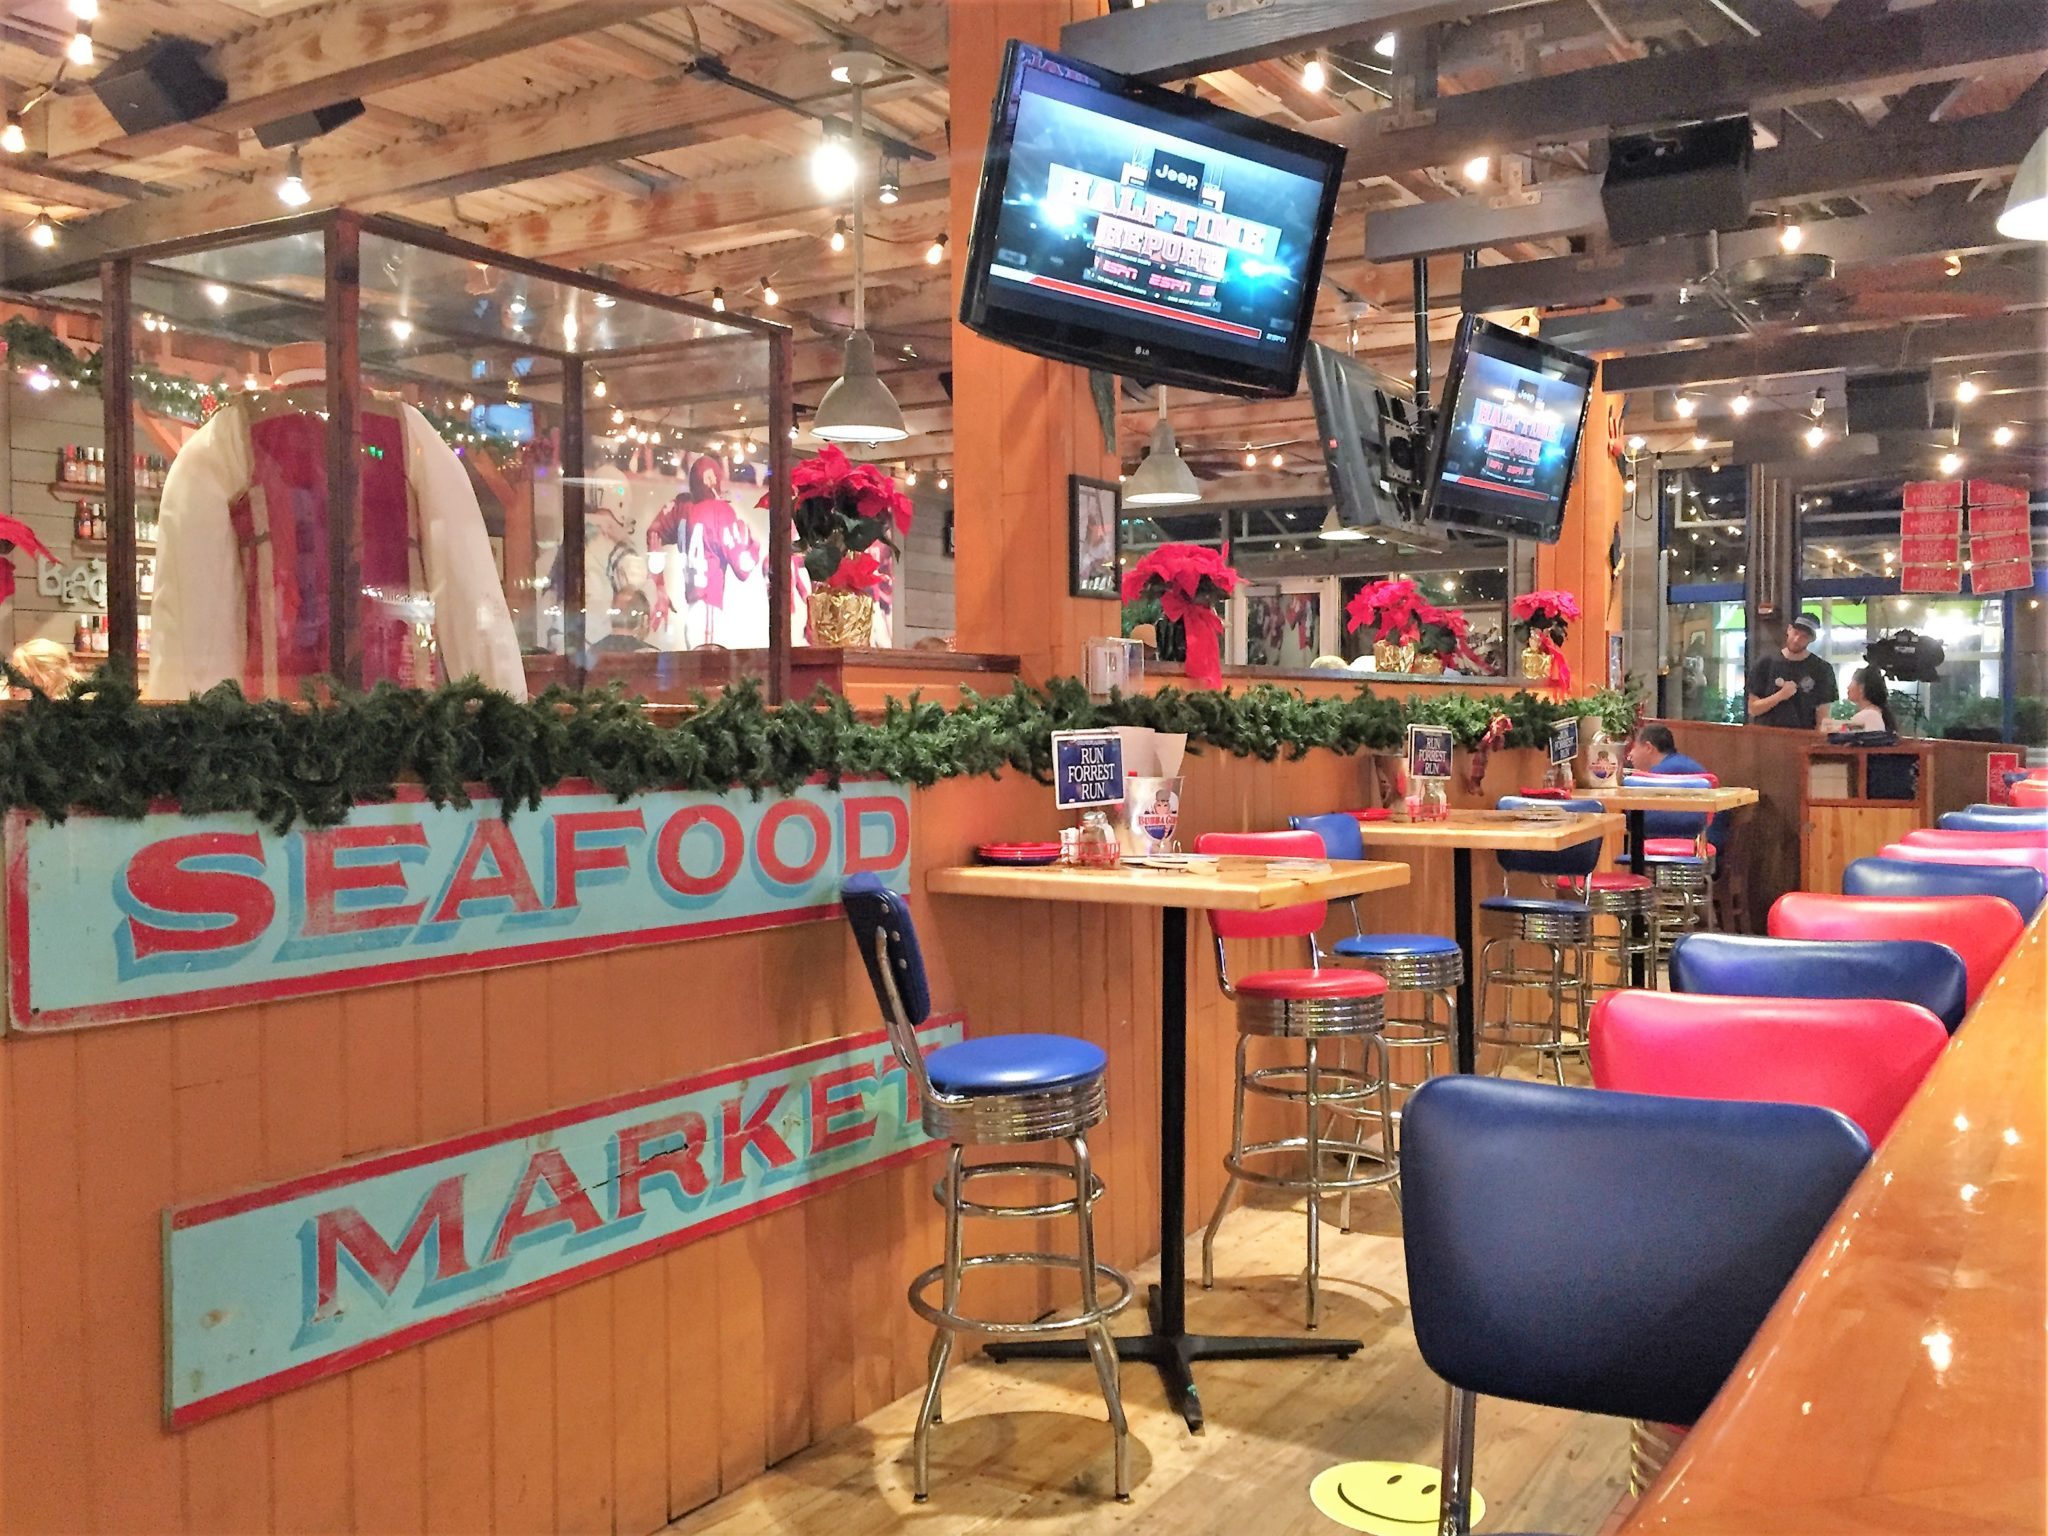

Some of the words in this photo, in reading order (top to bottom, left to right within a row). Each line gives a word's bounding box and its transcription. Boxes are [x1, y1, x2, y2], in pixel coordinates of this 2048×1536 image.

[1155, 164, 1199, 191] Jeep
[1064, 174, 1267, 254] HALFTIME
[1102, 224, 1219, 278] REPORT
[1102, 259, 1138, 280] ESPN
[1149, 273, 1191, 294] ESPN
[1518, 390, 1536, 404] Jeep
[1426, 737, 1441, 749] RUN
[1081, 747, 1104, 764] RUN
[1418, 749, 1447, 763] FORREST
[1068, 763, 1115, 783] FORREST
[1424, 761, 1440, 775] RUN
[1081, 782, 1105, 800] RUN
[113, 796, 910, 982] SEAFOOD
